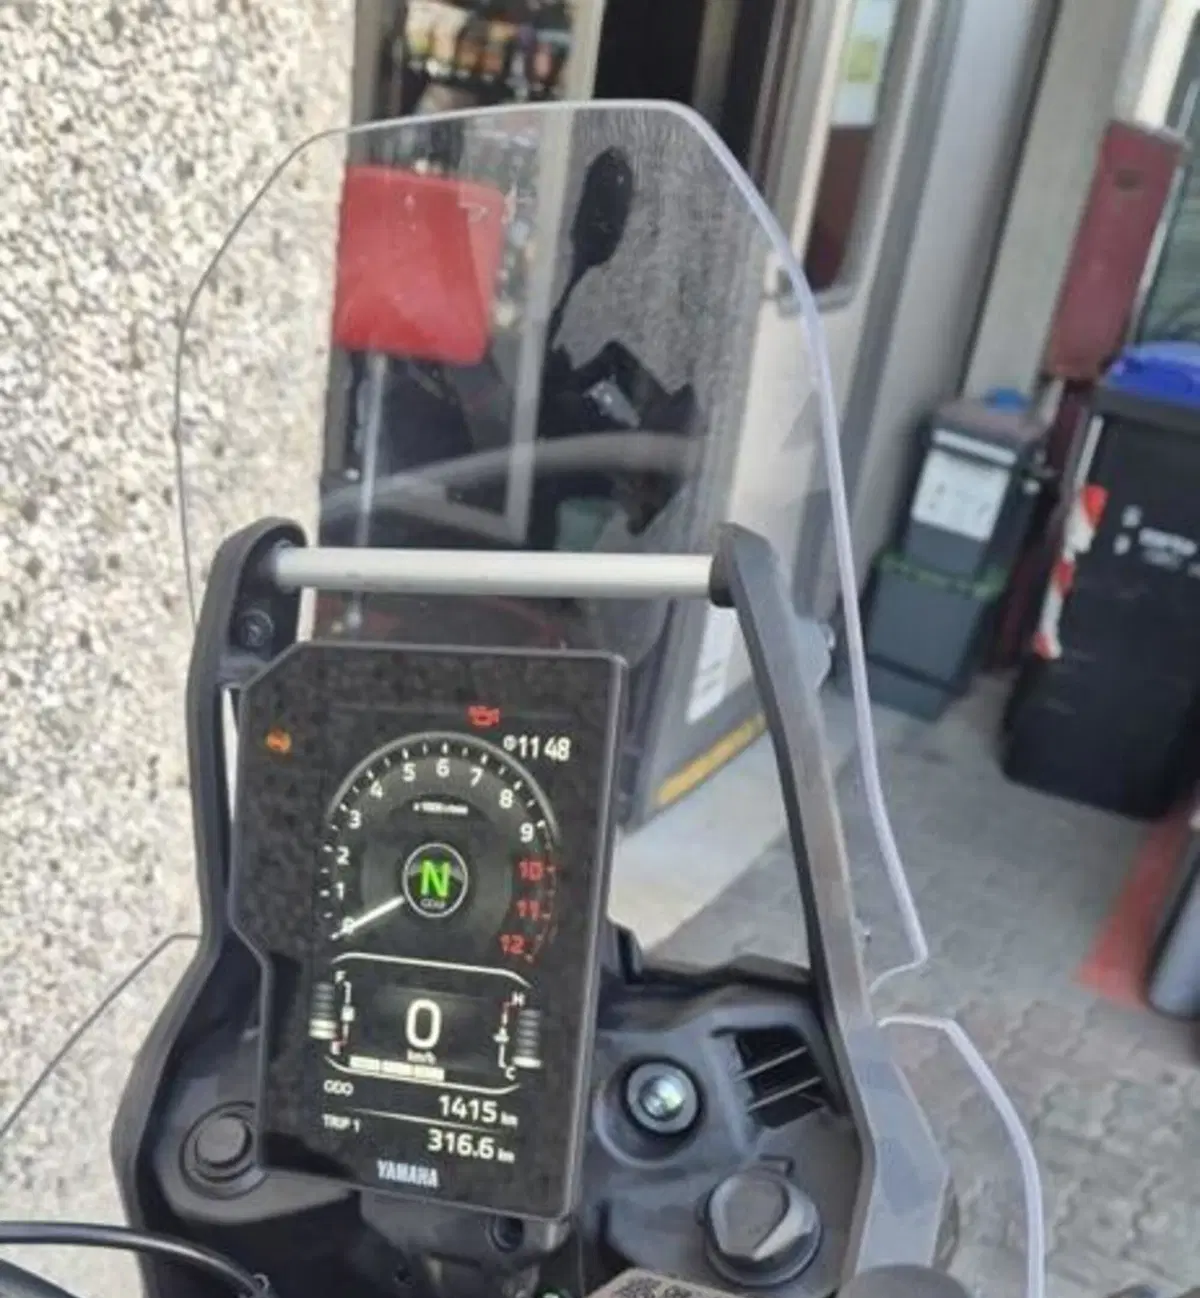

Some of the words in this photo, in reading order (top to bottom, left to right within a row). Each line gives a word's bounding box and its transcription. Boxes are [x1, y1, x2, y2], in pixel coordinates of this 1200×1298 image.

[402, 763, 416, 781] 5
[437, 759, 450, 777] 6
[470, 768, 484, 786] 7
[369, 780, 384, 798] 4
[499, 789, 513, 809] 8
[348, 810, 362, 828] 3
[519, 823, 534, 842] 9
[336, 849, 350, 865] 2
[420, 860, 449, 897] N
[519, 860, 543, 880] 10
[335, 883, 346, 898] 1
[516, 900, 540, 920] 11
[500, 933, 525, 953] 12
[405, 998, 442, 1049] 0
[438, 1094, 498, 1124] 1415
[501, 1112, 519, 1128] km
[427, 1128, 495, 1159] 316.6
[498, 1147, 515, 1163] km
[376, 1159, 440, 1188] YAMAHA
